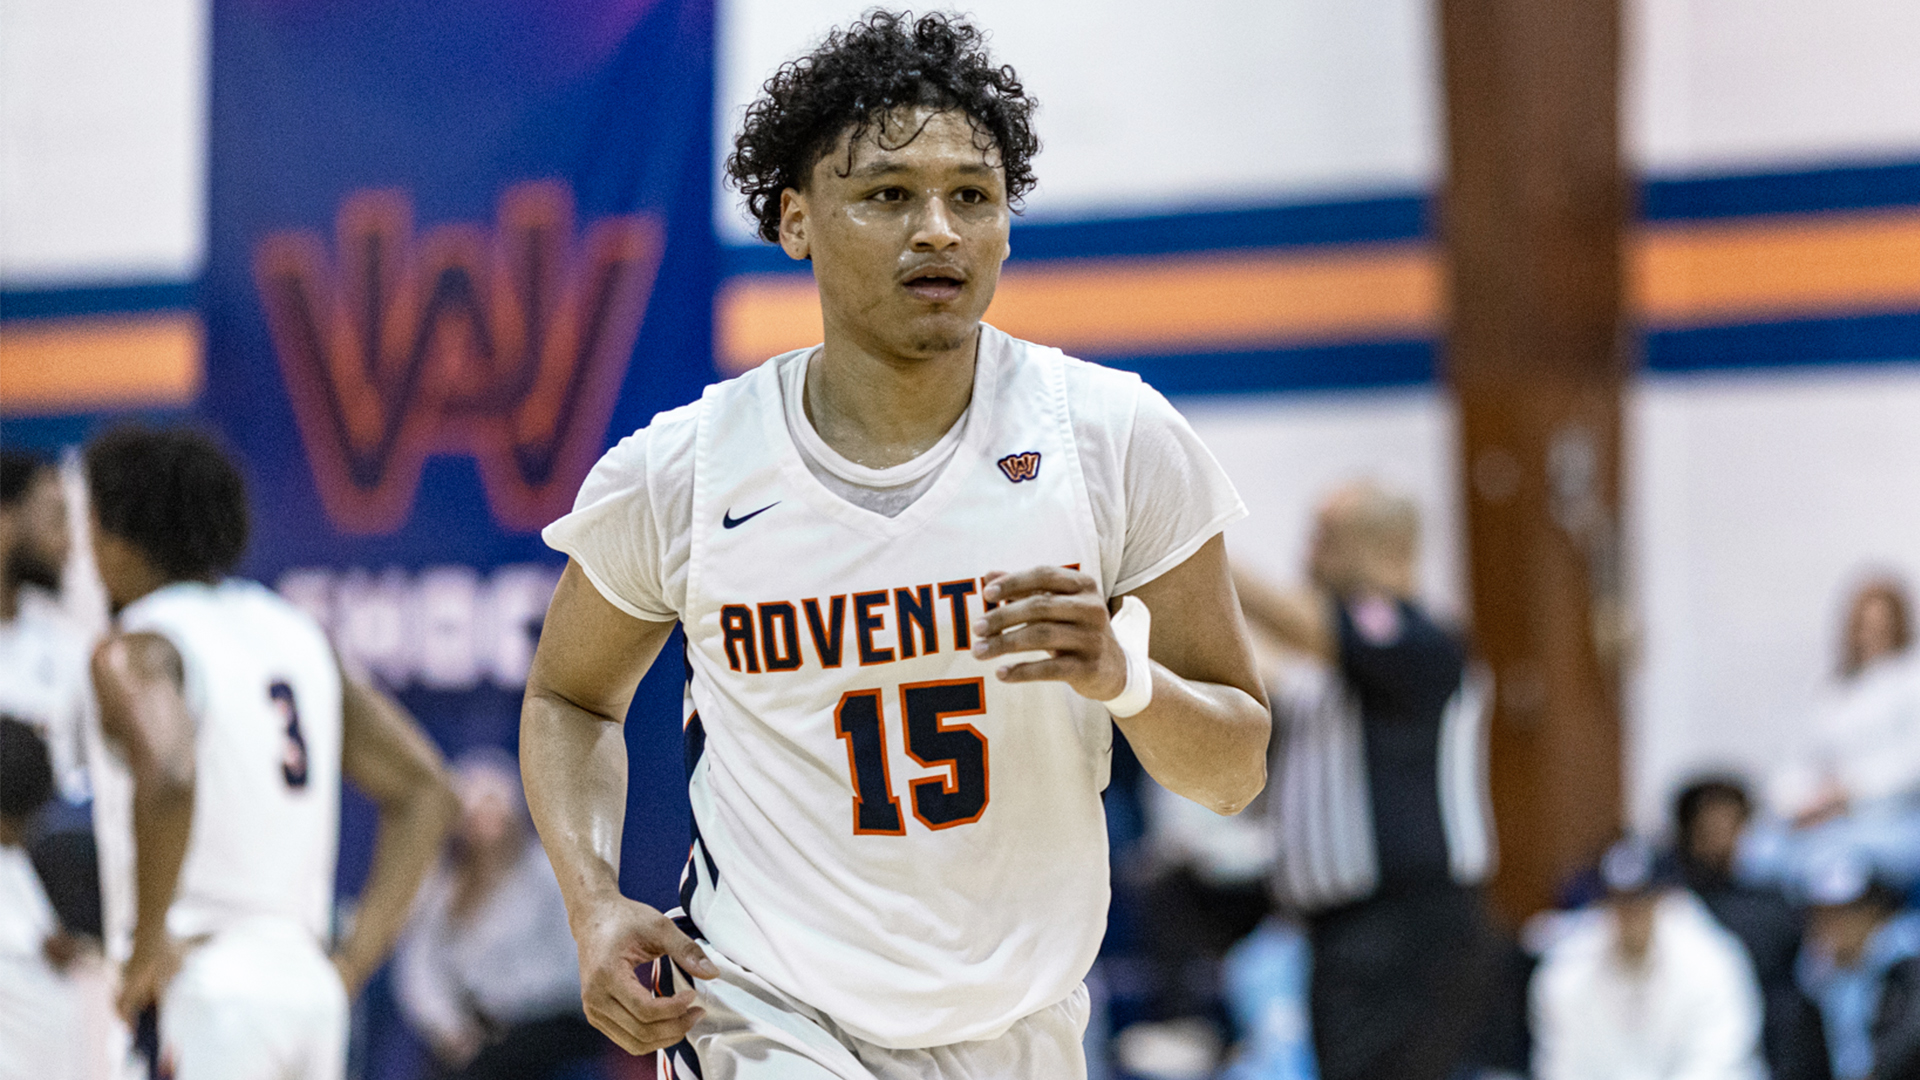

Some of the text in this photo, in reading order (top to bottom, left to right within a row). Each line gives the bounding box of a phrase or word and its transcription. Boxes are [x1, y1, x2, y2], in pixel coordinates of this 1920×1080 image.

[720, 563, 1081, 674] ADVENT
[268, 680, 309, 788] 3
[833, 676, 990, 836] 15
